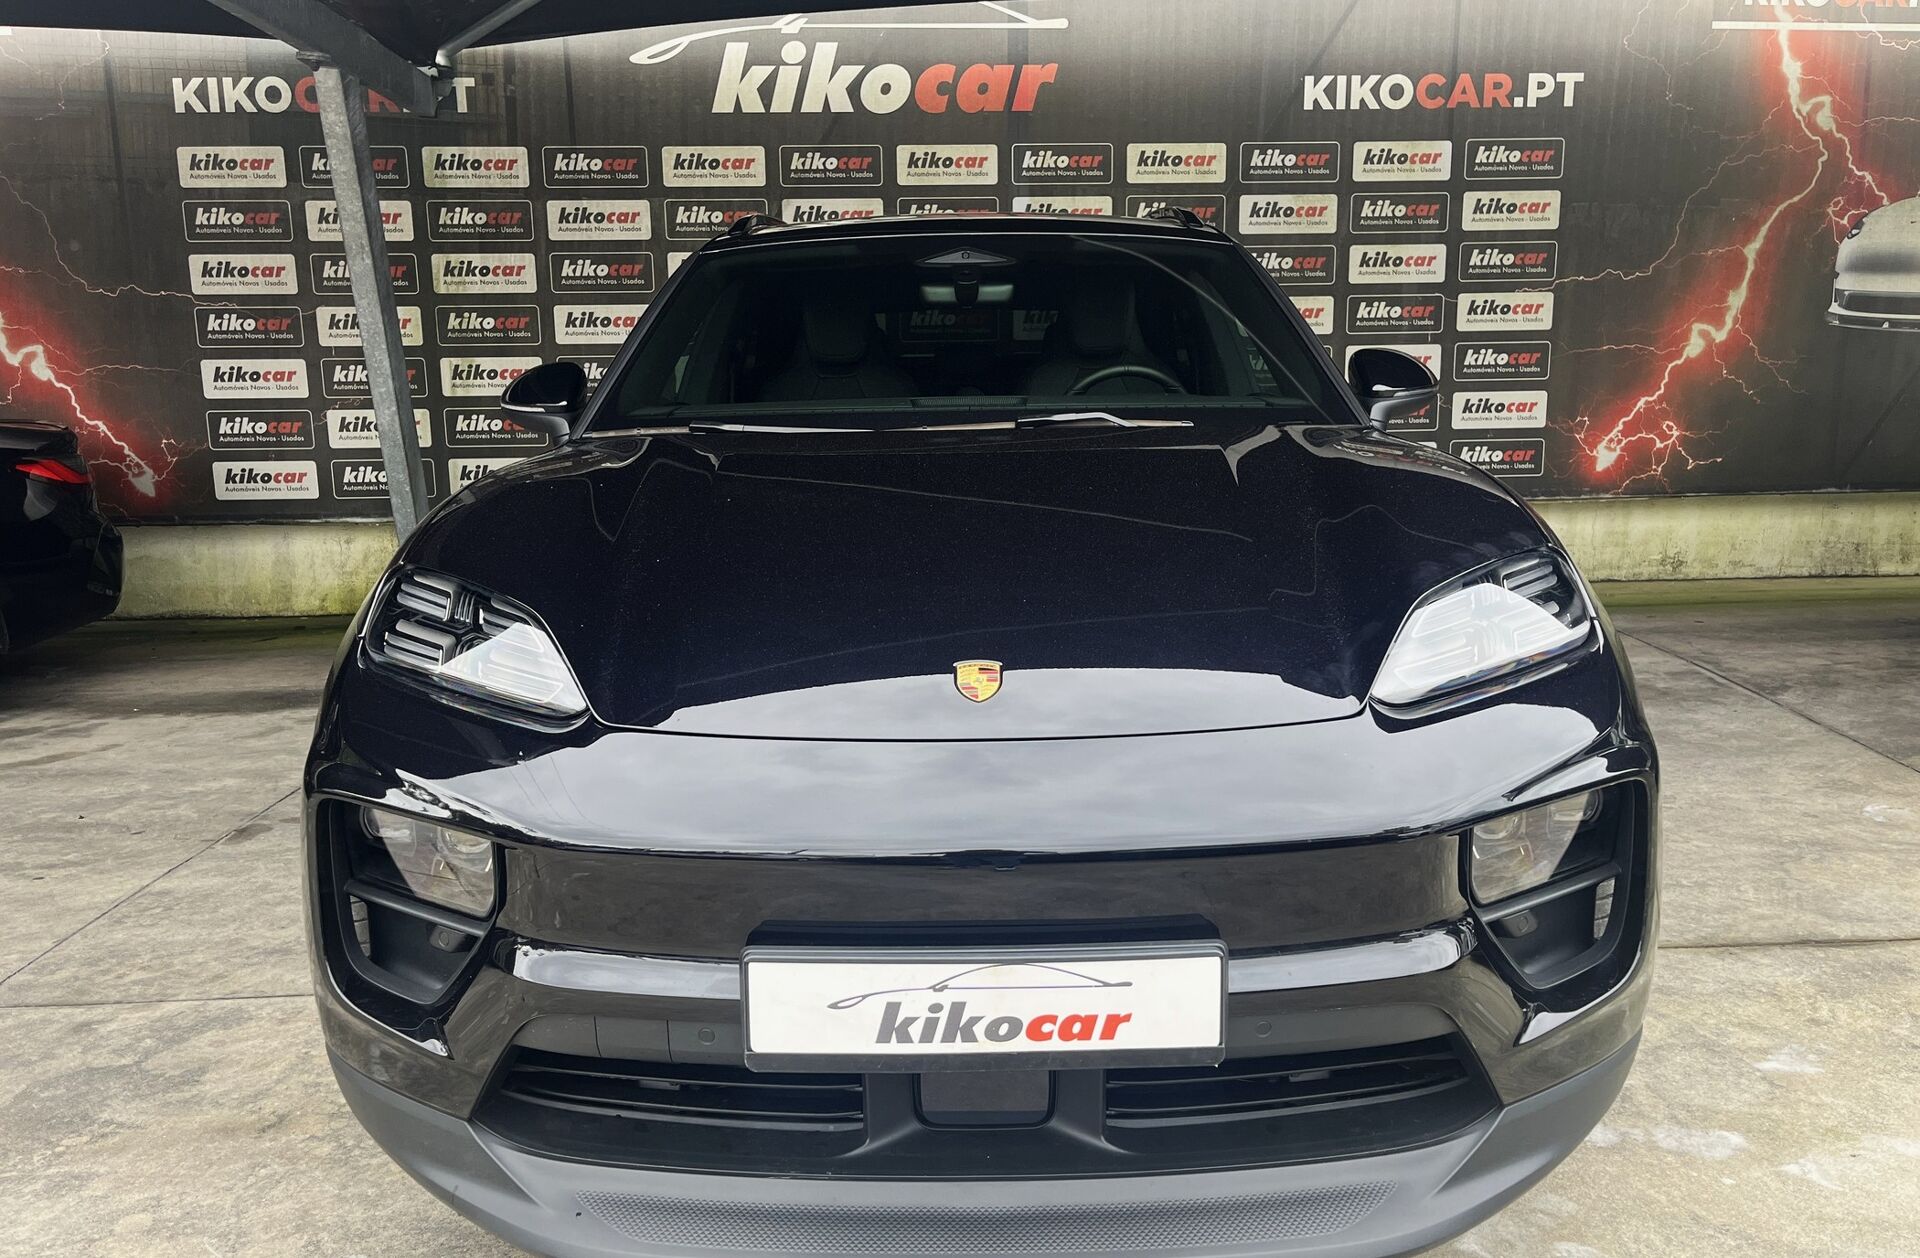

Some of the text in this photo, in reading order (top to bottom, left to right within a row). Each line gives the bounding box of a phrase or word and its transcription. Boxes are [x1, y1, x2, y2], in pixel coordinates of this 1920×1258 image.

[711, 41, 1059, 114] kikocar
[1303, 72, 1585, 110] KIKOCAR.PT
[189, 154, 274, 171] kikocar
[434, 154, 518, 171] kikocar
[554, 154, 637, 171] kikocar
[673, 153, 755, 170] kikocar
[790, 153, 872, 169] kikocar
[907, 152, 988, 168] kikocar
[1022, 151, 1103, 168] kikocar
[1137, 150, 1216, 167] kikocar
[1250, 149, 1329, 166] kikocar
[1363, 148, 1442, 165] kikocar
[1475, 146, 1554, 163] kikocar
[375, 172, 400, 180] Usados
[1249, 202, 1328, 218] kikocar
[1361, 200, 1439, 217] kikocar
[1472, 198, 1551, 214] kikocar
[195, 208, 279, 225] kikocar
[438, 207, 522, 224] kikocar
[558, 207, 640, 224] kikocar
[259, 226, 282, 234] Usados
[1359, 252, 1437, 268] kikocar
[1469, 249, 1547, 266] kikocar
[201, 261, 285, 278] kikocar
[443, 261, 526, 277] kikocar
[561, 260, 643, 277] kikocar
[1357, 302, 1434, 318] kikocar
[1467, 300, 1544, 316] kikocar
[207, 314, 291, 331] kikocar
[447, 312, 529, 329] kikocar
[564, 312, 640, 328] kikoca
[1464, 349, 1541, 365] kikocar
[213, 366, 296, 382] kikocar
[452, 364, 529, 380] kikoca
[1462, 398, 1538, 414] kikocar
[219, 417, 302, 434] kikocar
[456, 415, 525, 432] kikoc
[1460, 446, 1536, 462] kikocar
[225, 468, 307, 484] kikocar
[875, 1002, 1132, 1044] kikocar
